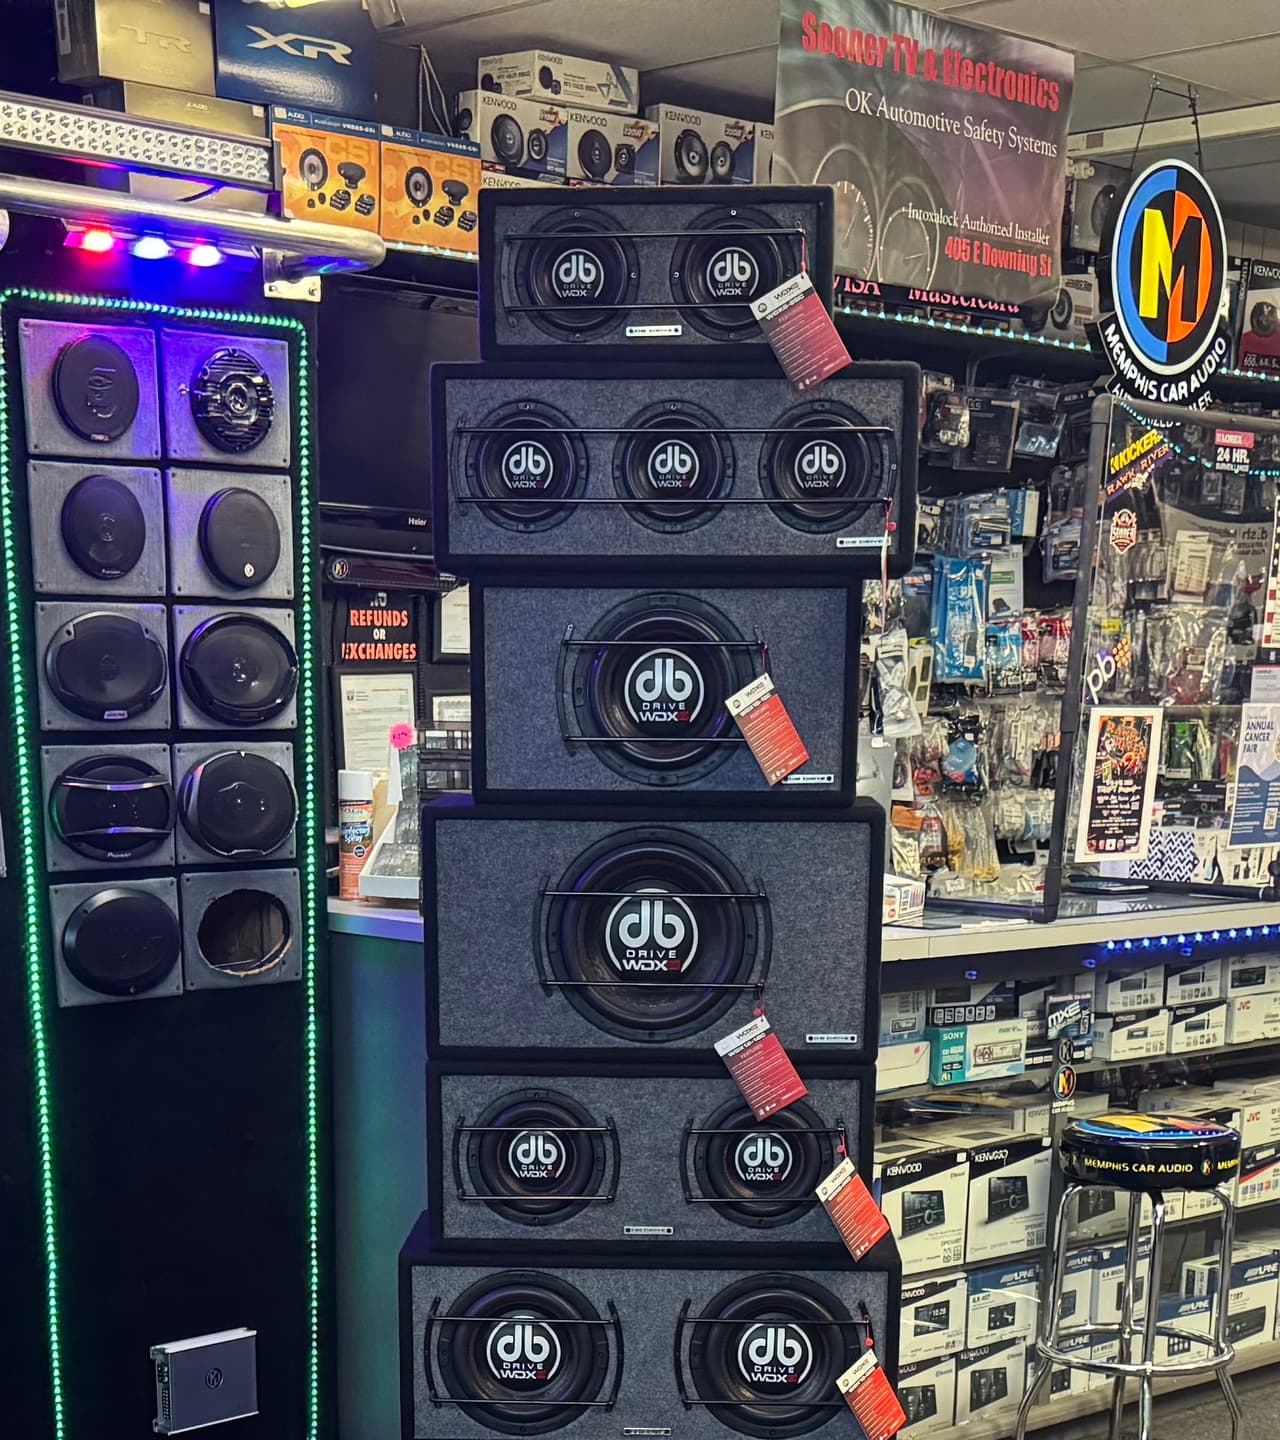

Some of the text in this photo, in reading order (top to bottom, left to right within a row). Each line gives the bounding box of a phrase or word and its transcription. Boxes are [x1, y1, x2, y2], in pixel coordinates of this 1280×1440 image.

[245, 24, 353, 65] XR
[801, 11, 1061, 112] Sooner TV & Electronics
[482, 96, 517, 111] KENWOOD
[570, 112, 608, 127] KENWOOD
[664, 111, 702, 126] KENWOOD
[845, 87, 1058, 158] OK Automotive Safety Systems
[908, 202, 1050, 246] Intoxalock Authorized Installer
[558, 254, 597, 282] db
[713, 252, 751, 282] db
[945, 236, 1053, 278] 405 E Downing St
[1104, 323, 1157, 400] MEMPHIS
[1160, 377, 1188, 403] CAR
[1190, 337, 1227, 393] AUDIO
[509, 445, 546, 475] db
[654, 444, 692, 475] db
[801, 445, 839, 475] db
[1110, 430, 1162, 475] KICKER
[1216, 447, 1250, 464] 24 HR.
[350, 609, 409, 627] REFUNDS
[373, 628, 386, 641] OR
[341, 642, 417, 661] EXCHANGES
[635, 658, 693, 702] db
[642, 702, 686, 710] DRIVE
[1244, 732, 1271, 742] CANCER
[1246, 720, 1275, 731] ANNUAL
[1242, 744, 1258, 754] FAIR
[618, 900, 685, 949] db
[625, 950, 677, 959] DRIVE
[1236, 1000, 1251, 1011] JVC
[942, 1031, 965, 1041] SONY
[1246, 1112, 1261, 1123] JVC
[516, 1135, 558, 1165] db
[743, 1137, 785, 1166] db
[887, 1162, 922, 1177] KENWOOD
[1085, 1158, 1194, 1173] MEMPHIS CAR AUDIO
[496, 1324, 550, 1363] db
[747, 1327, 802, 1365] db
[753, 1365, 795, 1373] DRIVE
